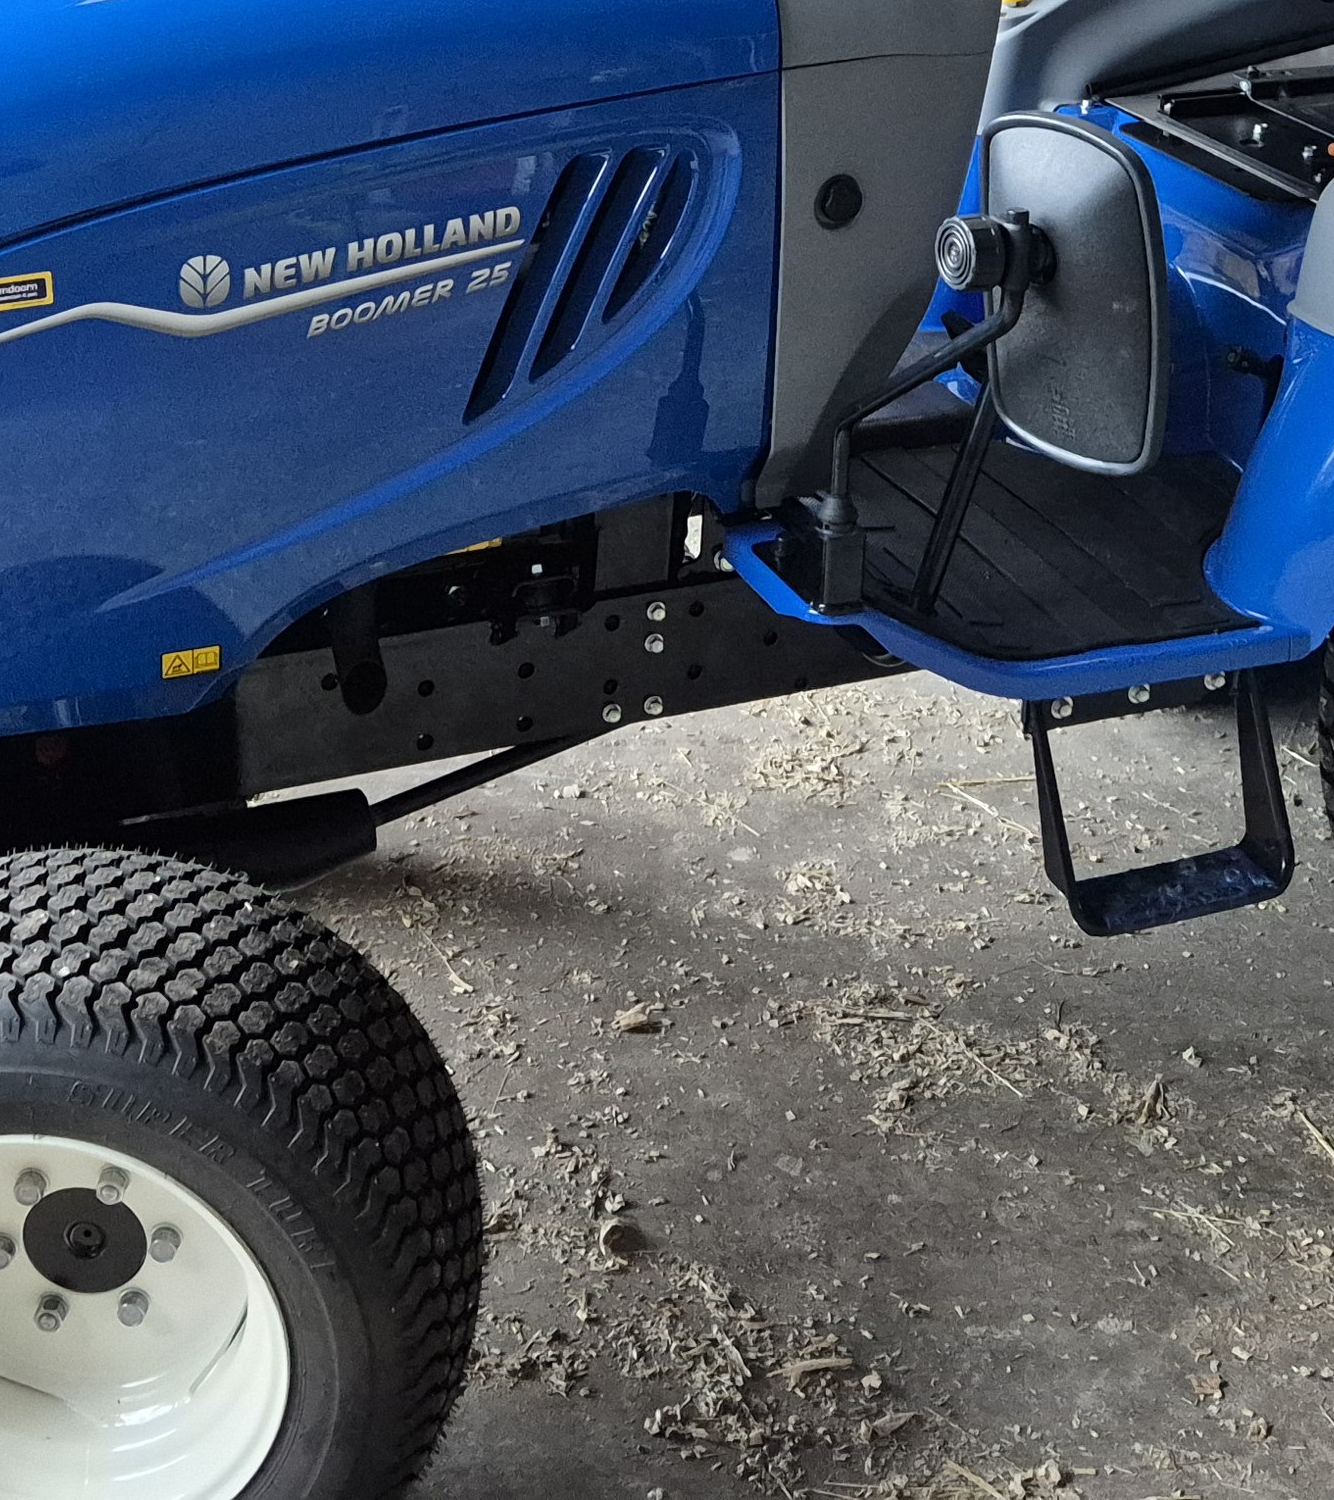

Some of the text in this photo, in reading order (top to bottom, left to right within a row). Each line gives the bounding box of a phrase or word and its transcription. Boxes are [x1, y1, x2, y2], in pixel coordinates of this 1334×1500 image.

[243, 205, 522, 300] NEW HOLLAND
[306, 260, 513, 340] BOOMER 25
